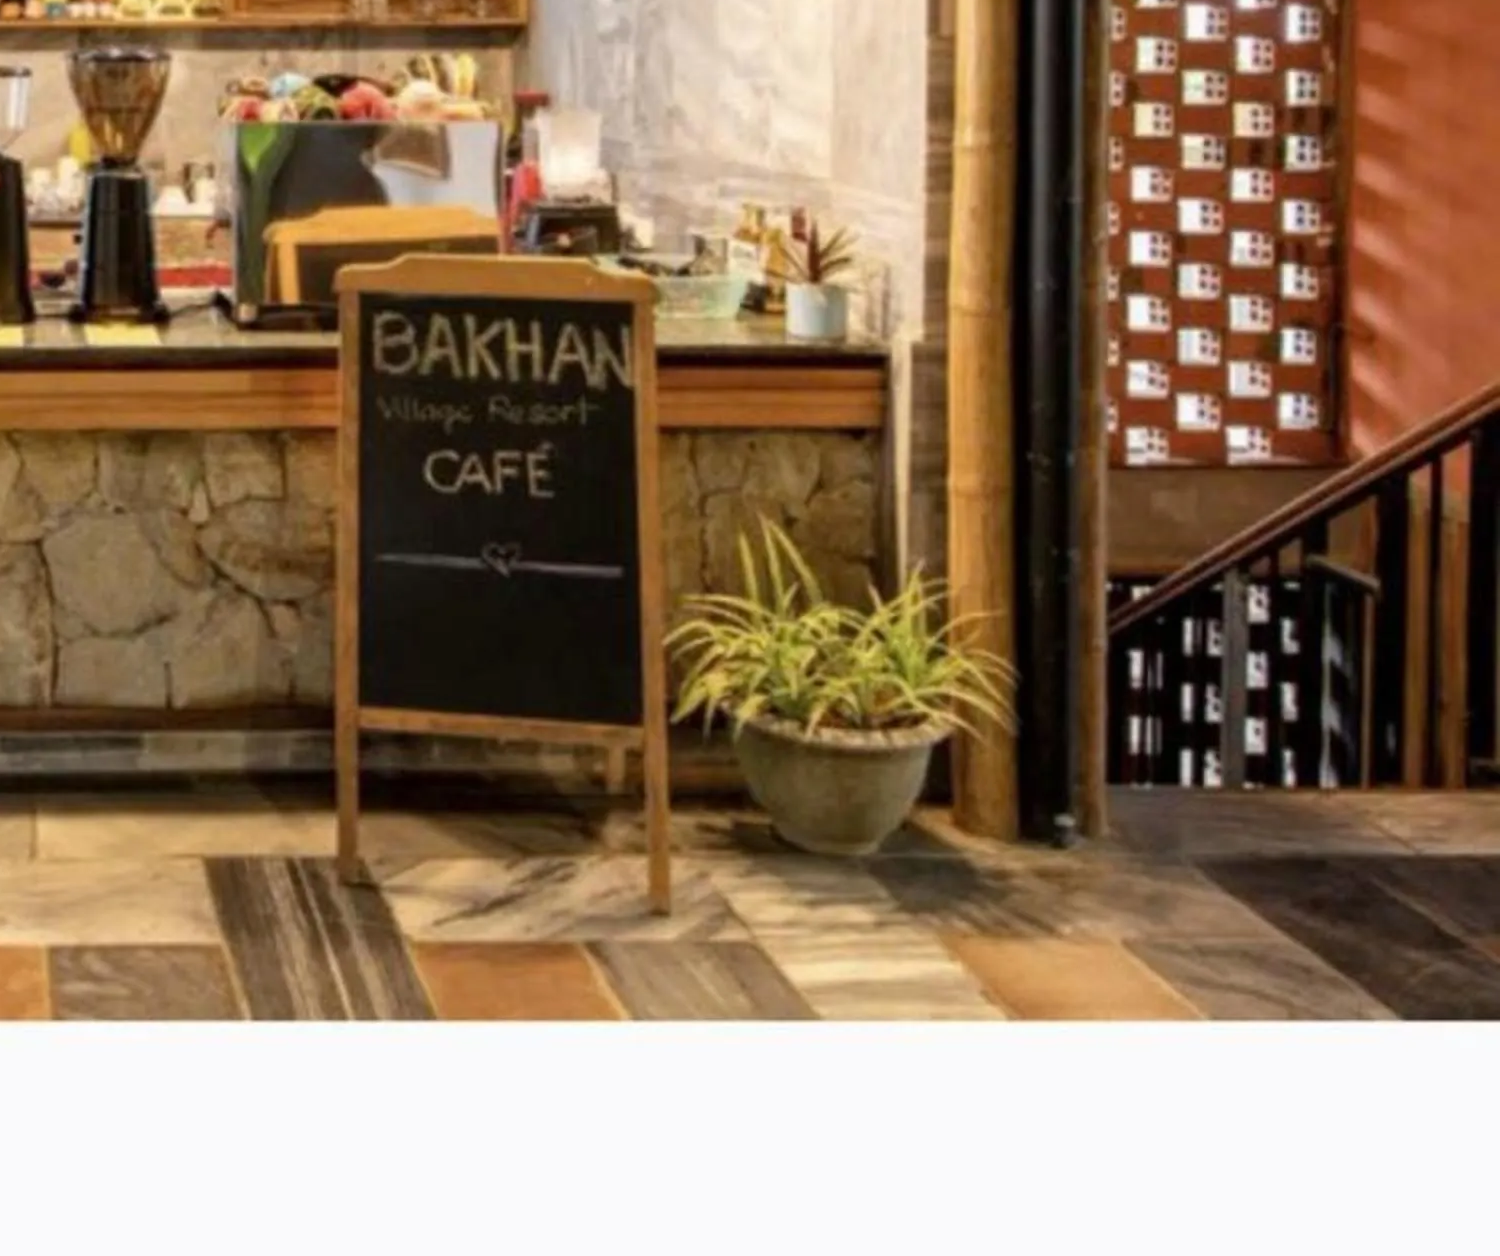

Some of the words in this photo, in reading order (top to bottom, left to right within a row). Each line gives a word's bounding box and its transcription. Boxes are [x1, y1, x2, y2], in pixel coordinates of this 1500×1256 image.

[374, 311, 634, 389] BAKHAN
[488, 394, 600, 425] Resort
[423, 441, 555, 498] CAFÉ
